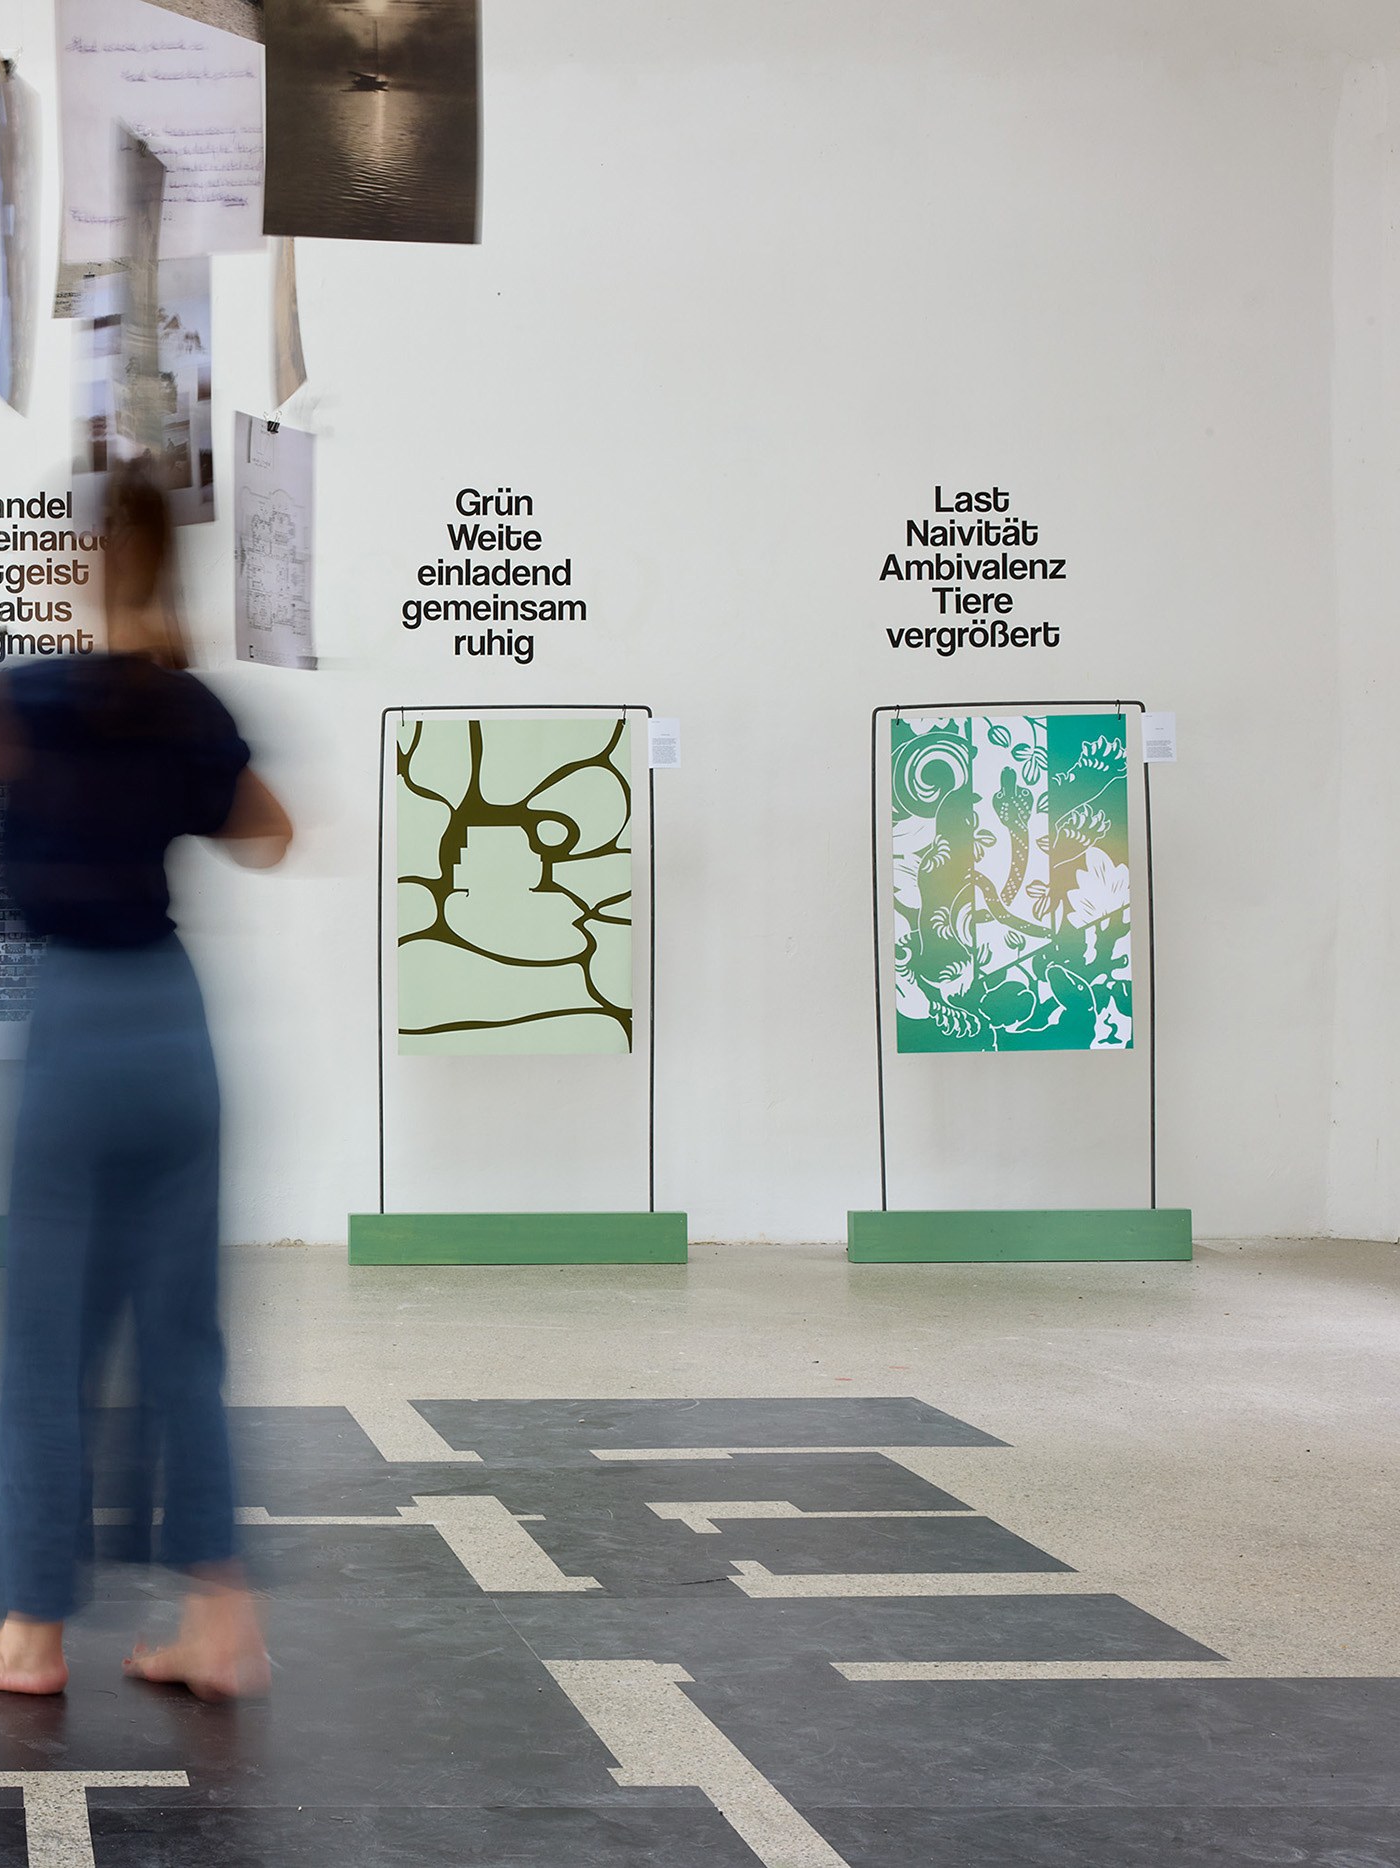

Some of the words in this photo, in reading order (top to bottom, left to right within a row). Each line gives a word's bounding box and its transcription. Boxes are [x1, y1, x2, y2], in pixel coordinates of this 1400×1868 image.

[455, 487, 533, 517] Grün
[934, 485, 1010, 513] Last
[446, 523, 543, 552] Weite
[906, 517, 1039, 547] Naivität
[417, 558, 571, 587] einladend
[878, 552, 1067, 581] Ambivalenz
[401, 593, 587, 630] gemeinsam
[931, 586, 1014, 615] Tiere
[454, 628, 534, 665] ruhig
[885, 618, 1060, 657] vergrößert
